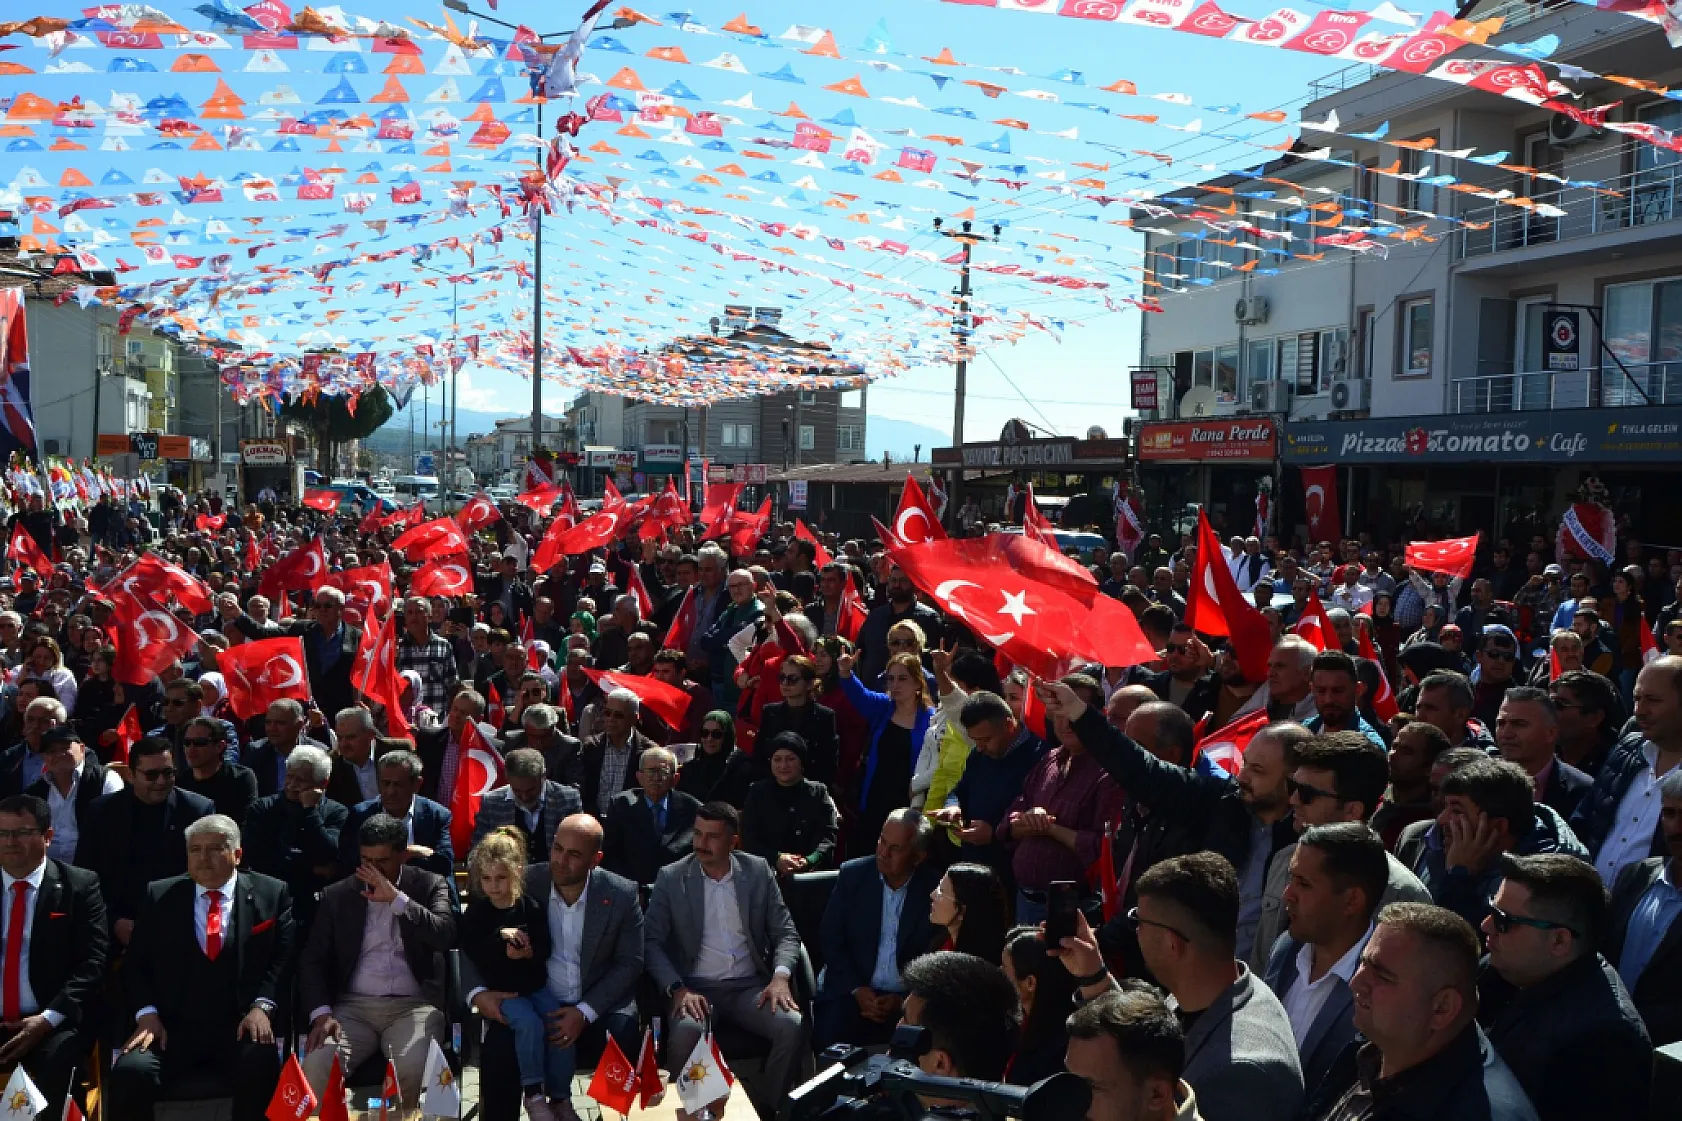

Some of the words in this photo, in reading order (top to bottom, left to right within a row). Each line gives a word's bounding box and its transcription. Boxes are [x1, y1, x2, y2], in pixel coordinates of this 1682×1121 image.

[1190, 427, 1224, 442] Rana
[1228, 424, 1269, 441] Perde
[1622, 424, 1645, 434] TIKLA
[1340, 431, 1401, 456] Pizza
[1430, 430, 1530, 452] Tomato
[1550, 432, 1588, 457] Cafe
[294, 1094, 311, 1118] MHP
